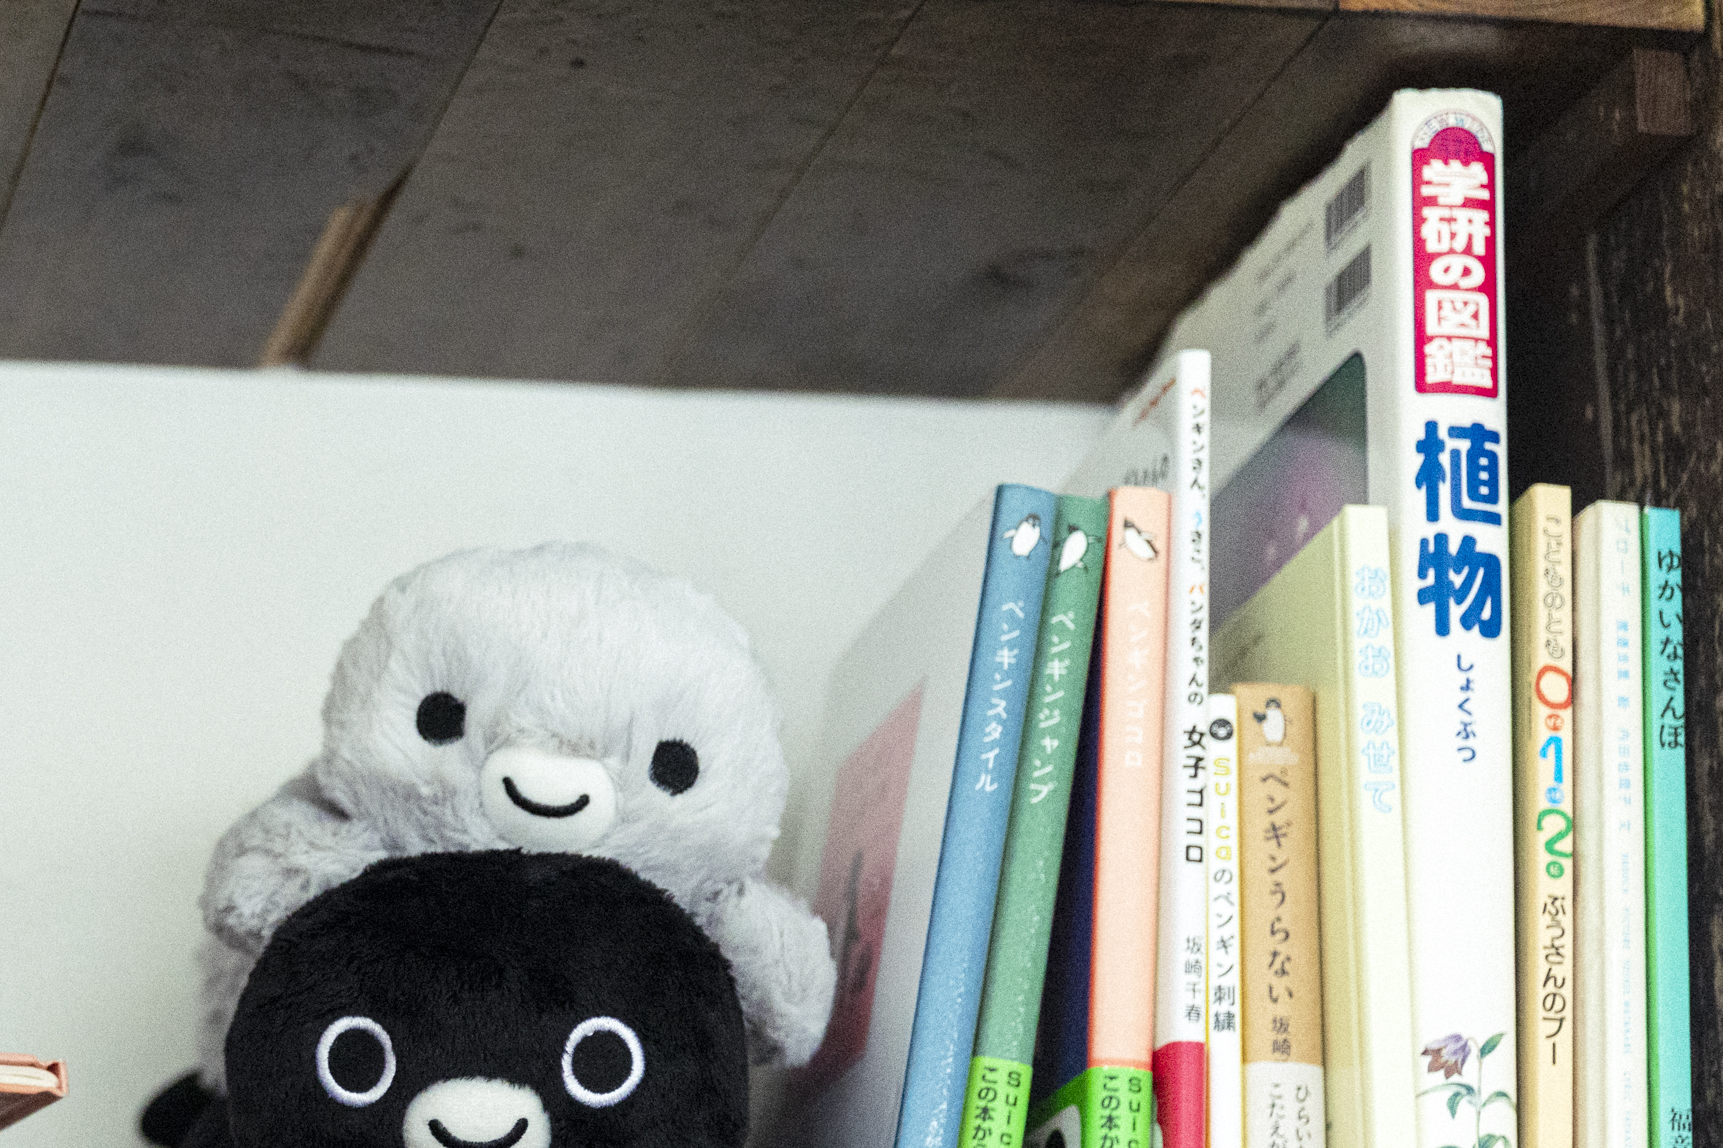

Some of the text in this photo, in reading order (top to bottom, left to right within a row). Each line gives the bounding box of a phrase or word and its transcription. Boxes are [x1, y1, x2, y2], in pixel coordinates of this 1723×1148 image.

[1420, 159, 1493, 389] 学研の図鑑
[1415, 420, 1503, 639] 植物
[975, 600, 1025, 793] ペンギンスタイル
[1029, 610, 1076, 804] ペンギンジャンプ
[1456, 653, 1477, 764] しょくぶつ
[1656, 549, 1685, 749] ゆかいなさんぽ
[1182, 725, 1207, 864] 女子ゴコロ
[1184, 935, 1204, 1024] 坂崎千春
[1260, 766, 1294, 1061] ペンギンうらない 坂崎
